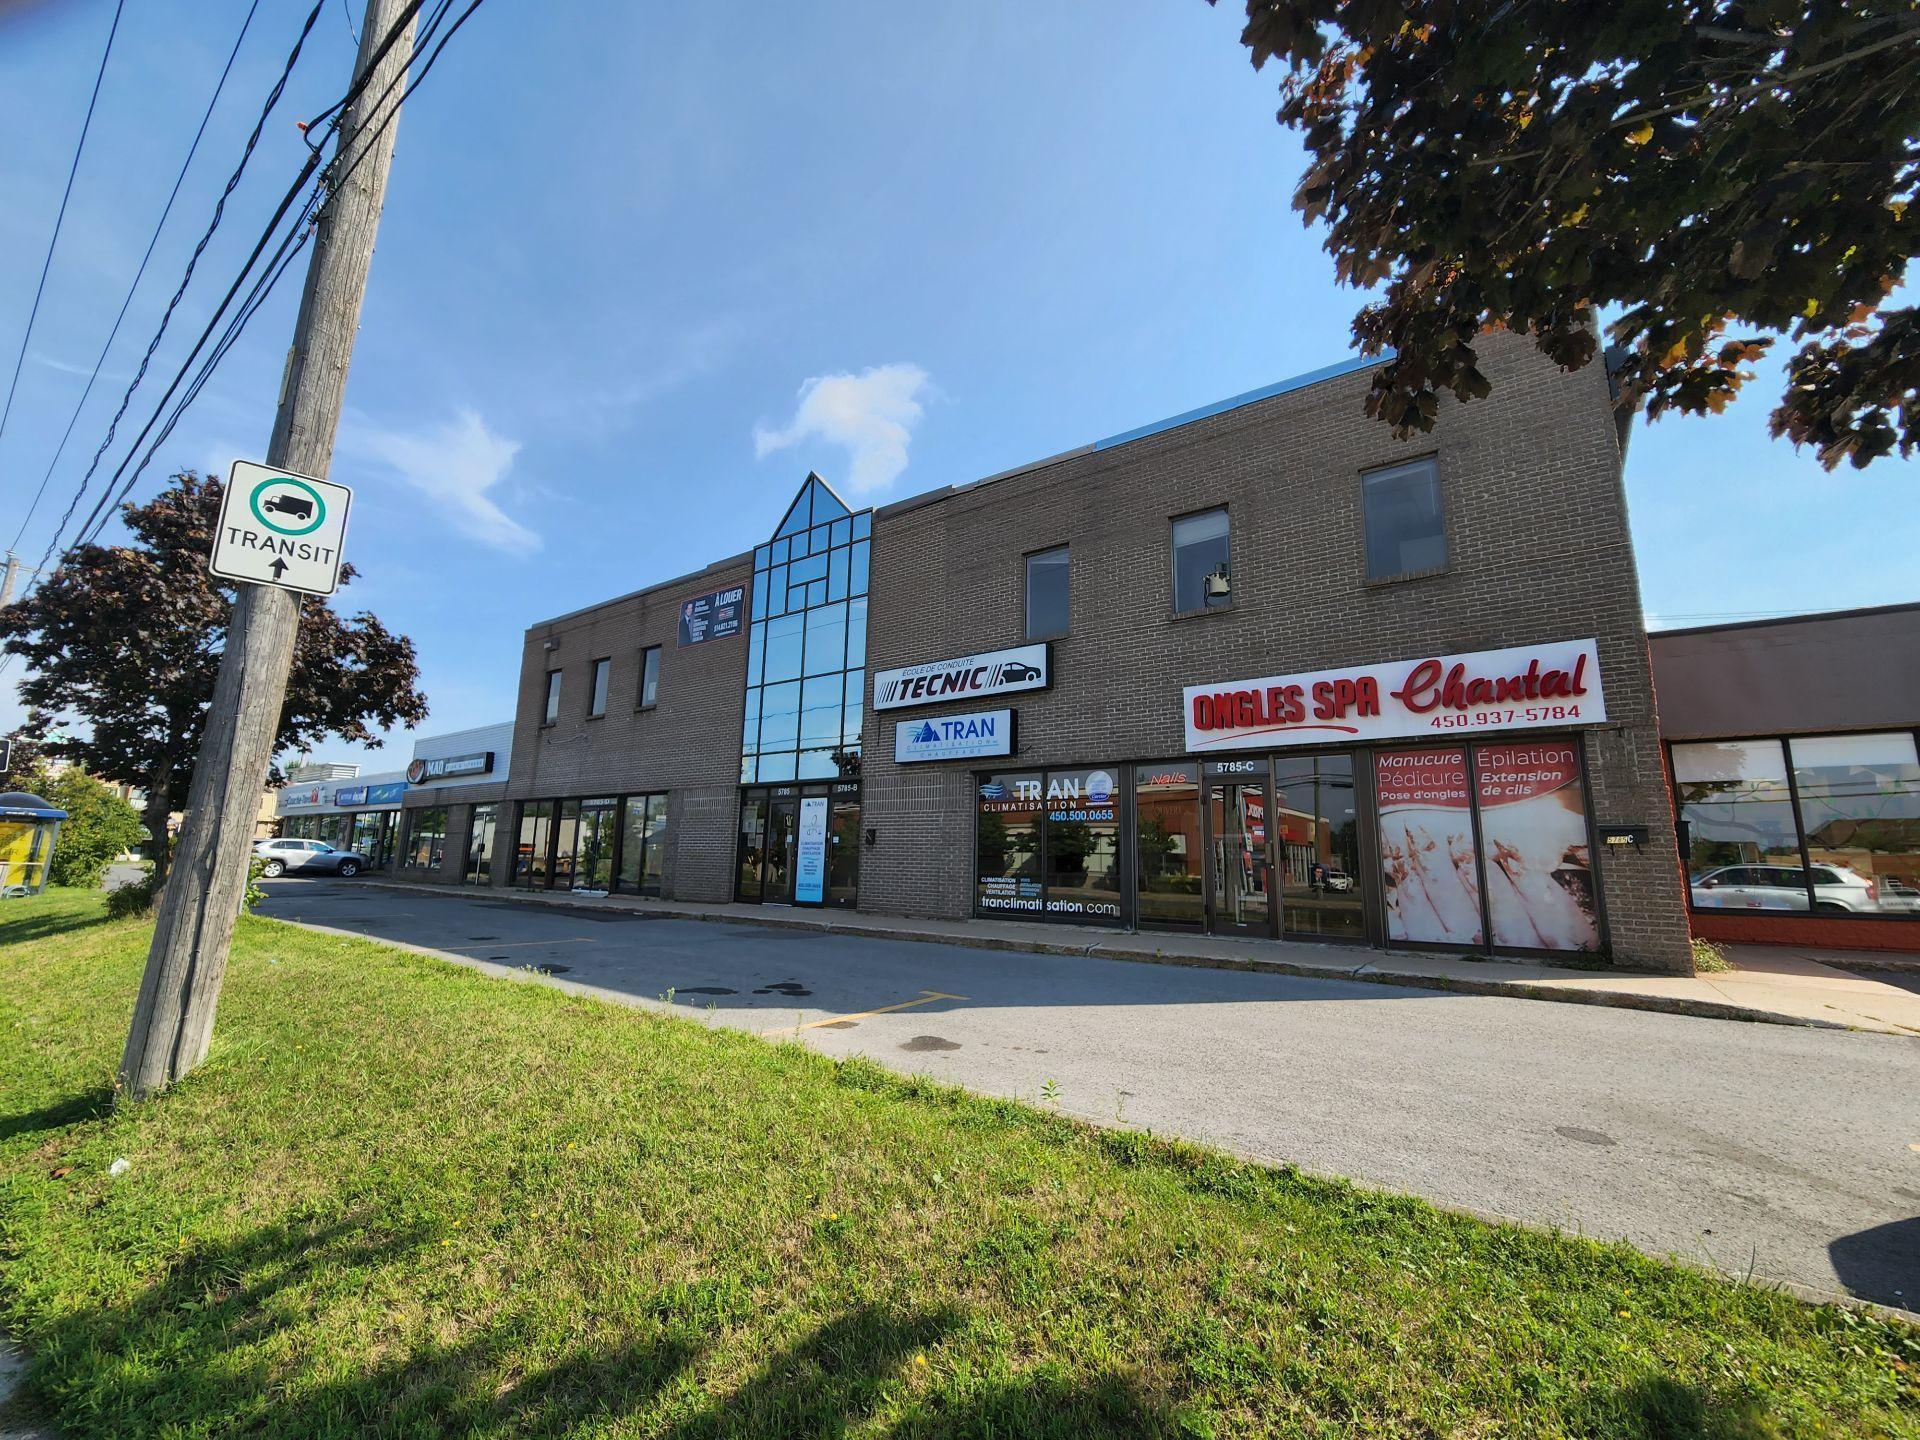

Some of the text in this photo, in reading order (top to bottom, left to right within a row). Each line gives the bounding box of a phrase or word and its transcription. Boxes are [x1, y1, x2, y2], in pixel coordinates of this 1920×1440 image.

[228, 527, 334, 564] TRANSIT
[720, 589, 742, 606] LOUER
[926, 664, 936, 673] DE
[937, 659, 975, 671] CONDUITE
[900, 666, 988, 701] TECNIC
[1390, 654, 1587, 714] Chantal
[1192, 676, 1381, 731] ONGLES SPA
[1431, 705, 1581, 728] 450.937-5784
[941, 718, 995, 740] TRAN
[1379, 754, 1462, 768] Manucure
[1477, 749, 1574, 768] Épilation
[1217, 761, 1254, 772] 5785-C
[1150, 772, 1187, 786] Nails
[1379, 771, 1464, 786] Pédicure
[1480, 771, 1562, 783] Extension
[1015, 778, 1079, 801] TRAN
[1380, 789, 1466, 801] Pose d'ongles
[1482, 785, 1532, 796] de cils
[983, 800, 1077, 811] CLIMATISATION
[1050, 810, 1113, 821] 450.500.0655
